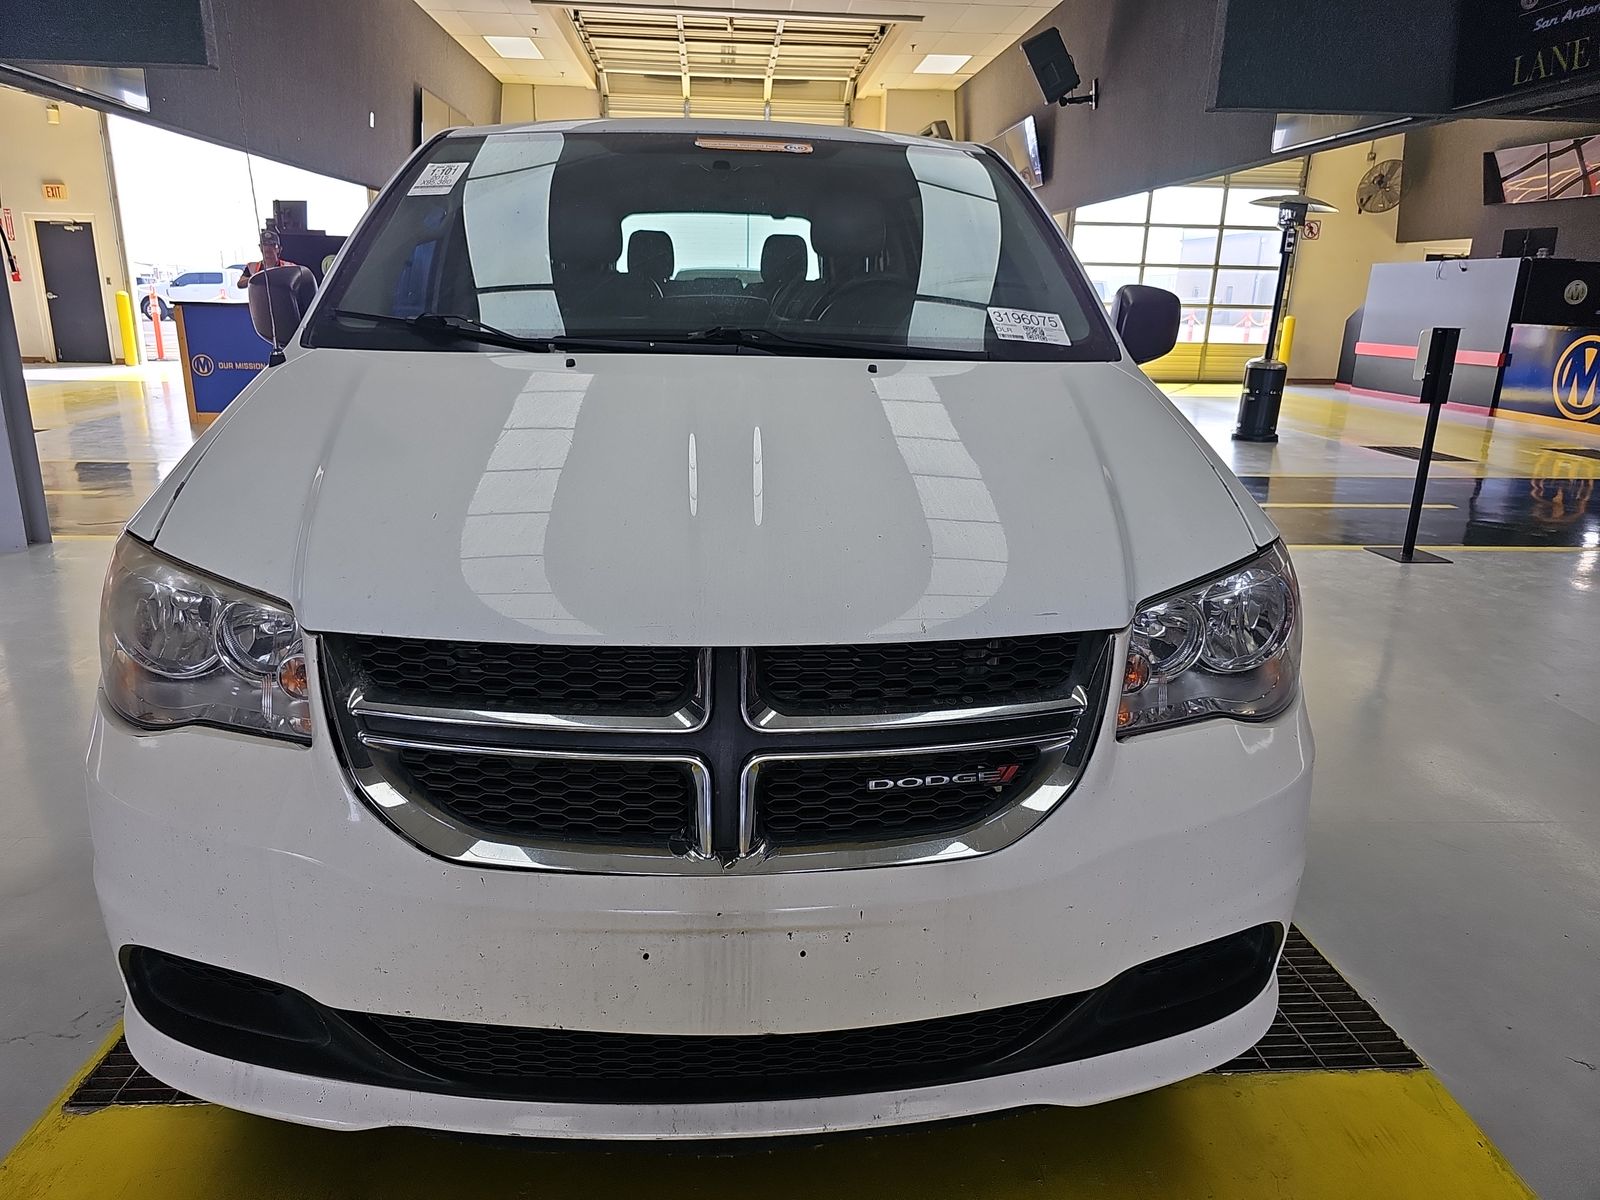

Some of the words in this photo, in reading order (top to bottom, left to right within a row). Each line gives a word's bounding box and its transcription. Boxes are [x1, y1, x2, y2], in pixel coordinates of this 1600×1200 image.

[1533, 17, 1559, 32] San
[1512, 37, 1590, 86] LANE
[46, 186, 61, 198] EXIT
[993, 310, 1058, 328] 3196075
[218, 361, 234, 370] OUR
[235, 361, 266, 371] MISSION
[868, 771, 1002, 791] DODGE
